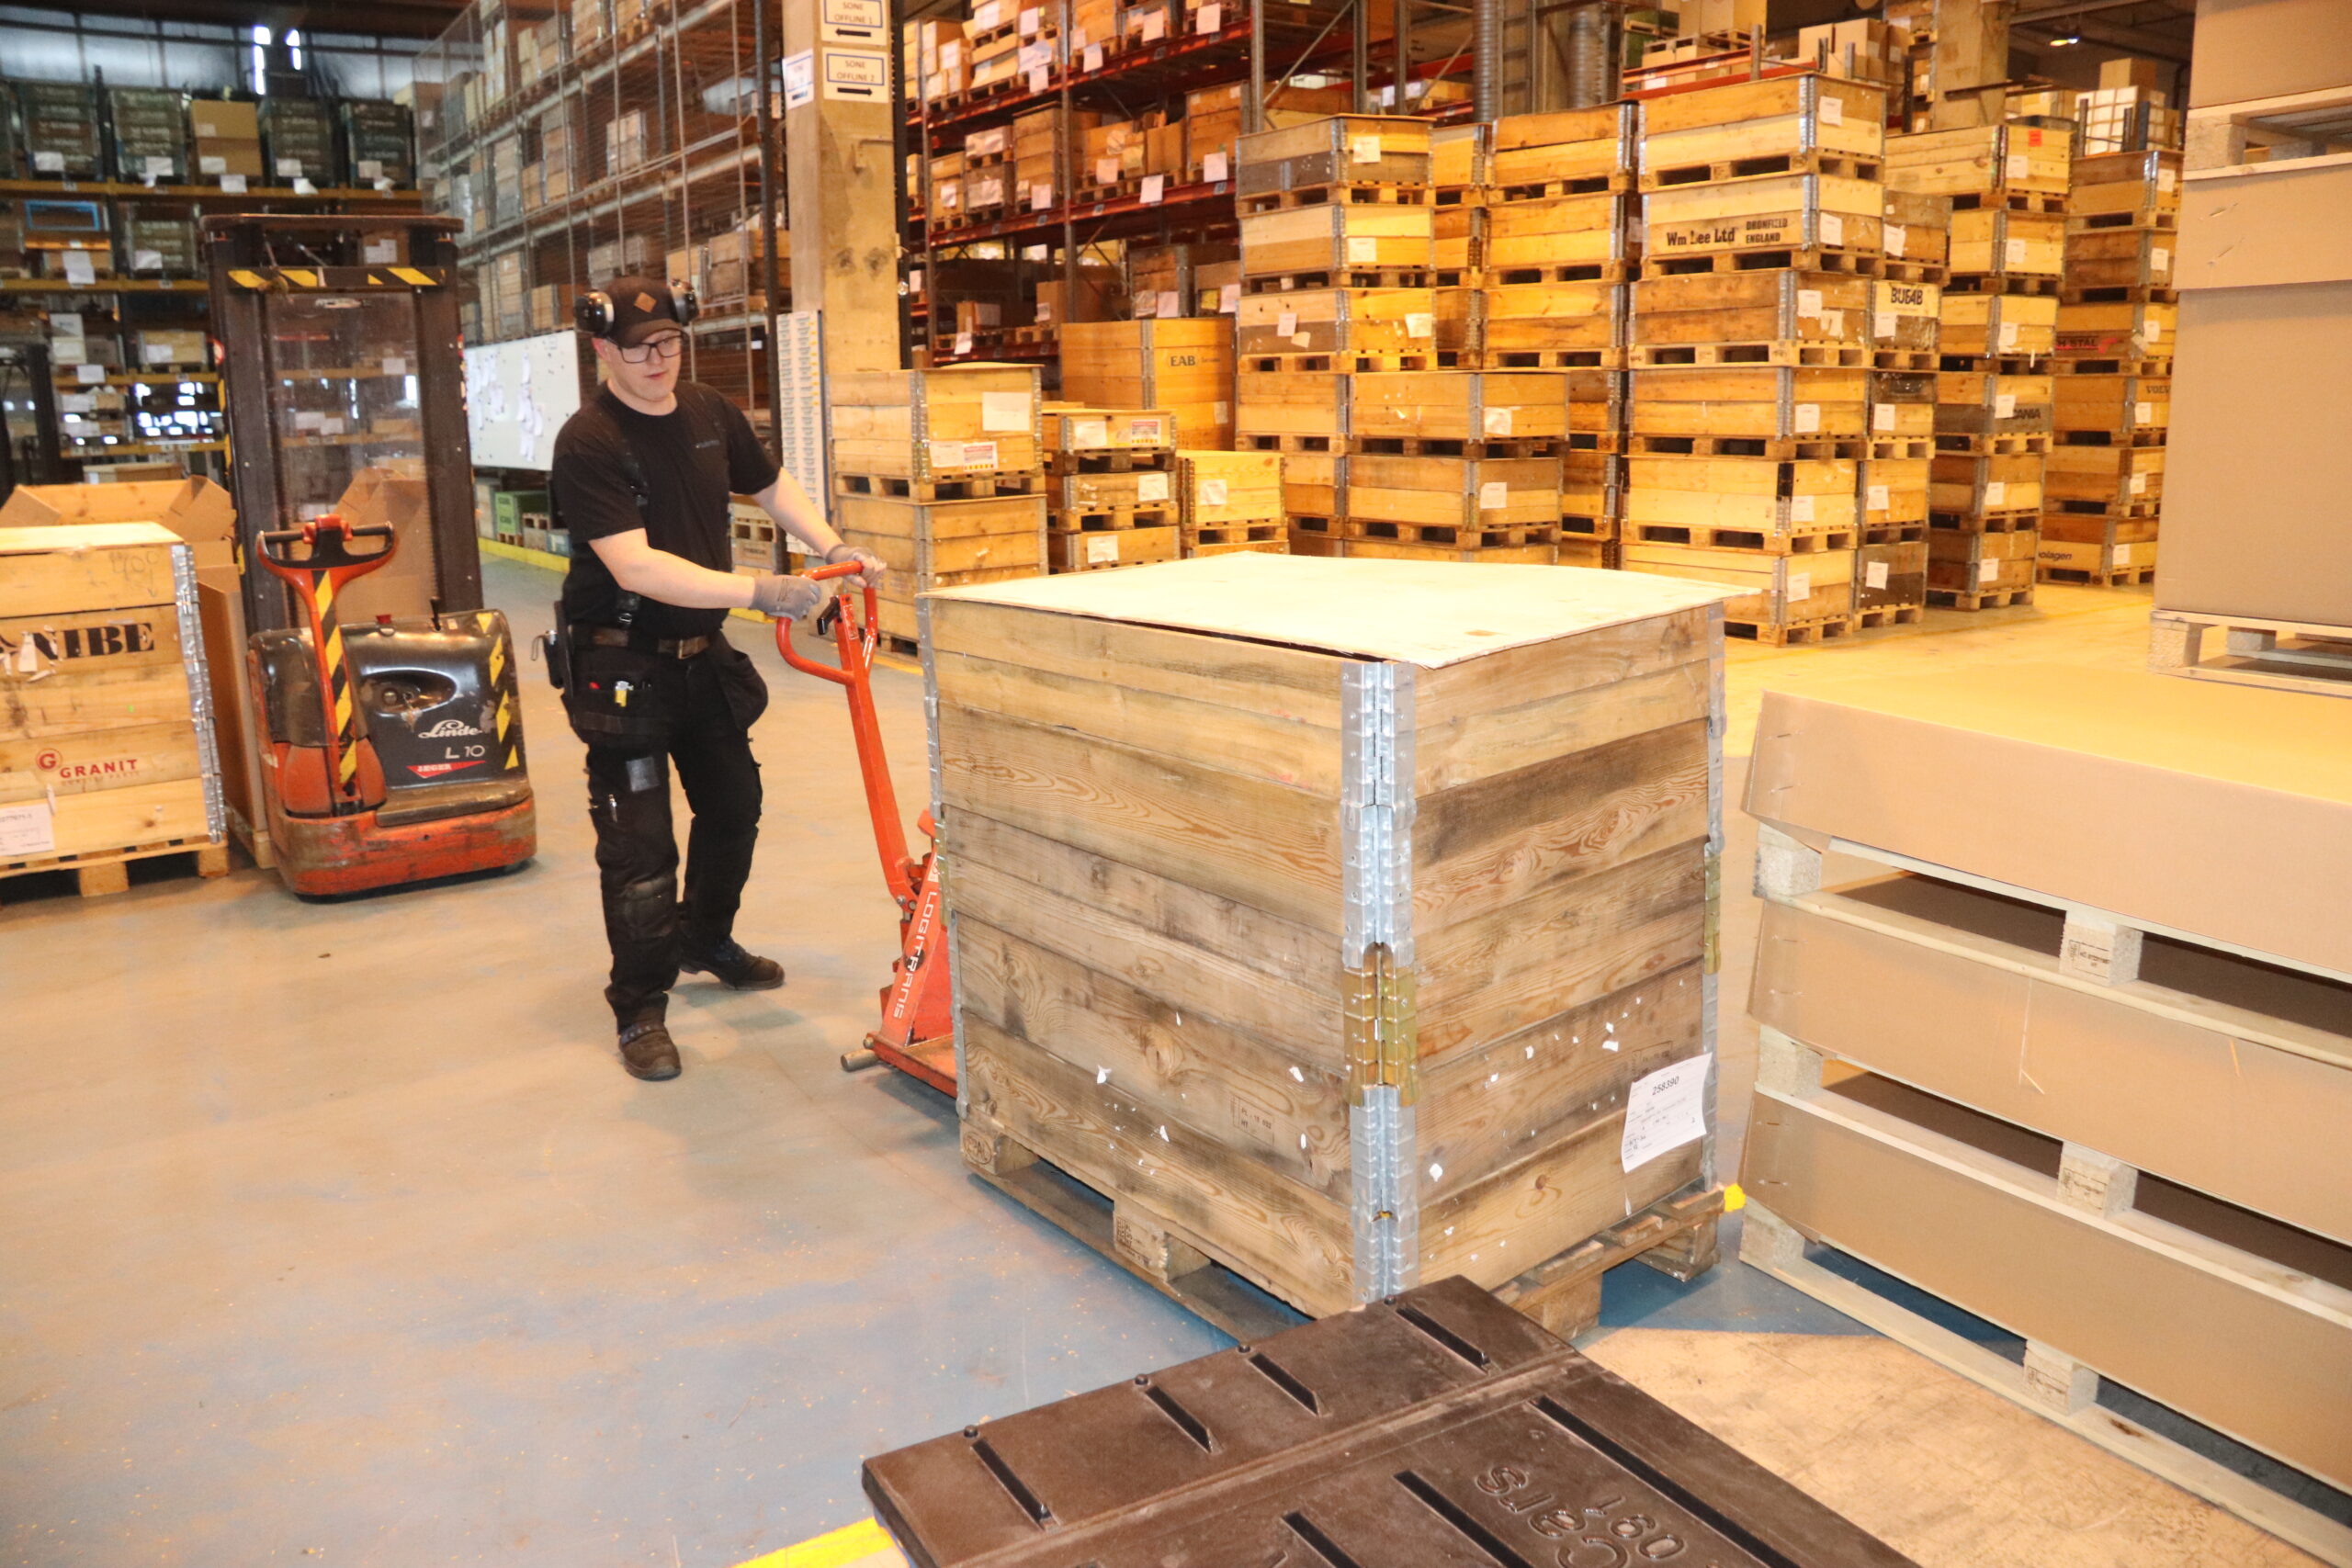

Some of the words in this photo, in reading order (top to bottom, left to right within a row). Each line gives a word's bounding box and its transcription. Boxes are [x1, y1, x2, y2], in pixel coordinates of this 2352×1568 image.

[842, 2, 864, 11] SONE
[834, 14, 865, 24] OFFLINE
[844, 60, 865, 69] SONE
[836, 72, 867, 82] OFFLINE
[1666, 231, 1687, 246] Wm
[1714, 227, 1736, 243] Ltd
[1746, 231, 1781, 243] ENGLAND
[1170, 355, 1196, 367] EAB
[417, 719, 483, 739] Linde
[445, 747, 460, 760] L
[464, 745, 486, 758] 10
[60, 759, 138, 779] GRANIT
[893, 891, 938, 1020] LOGITRANS
[1476, 1466, 1629, 1568] Cars
